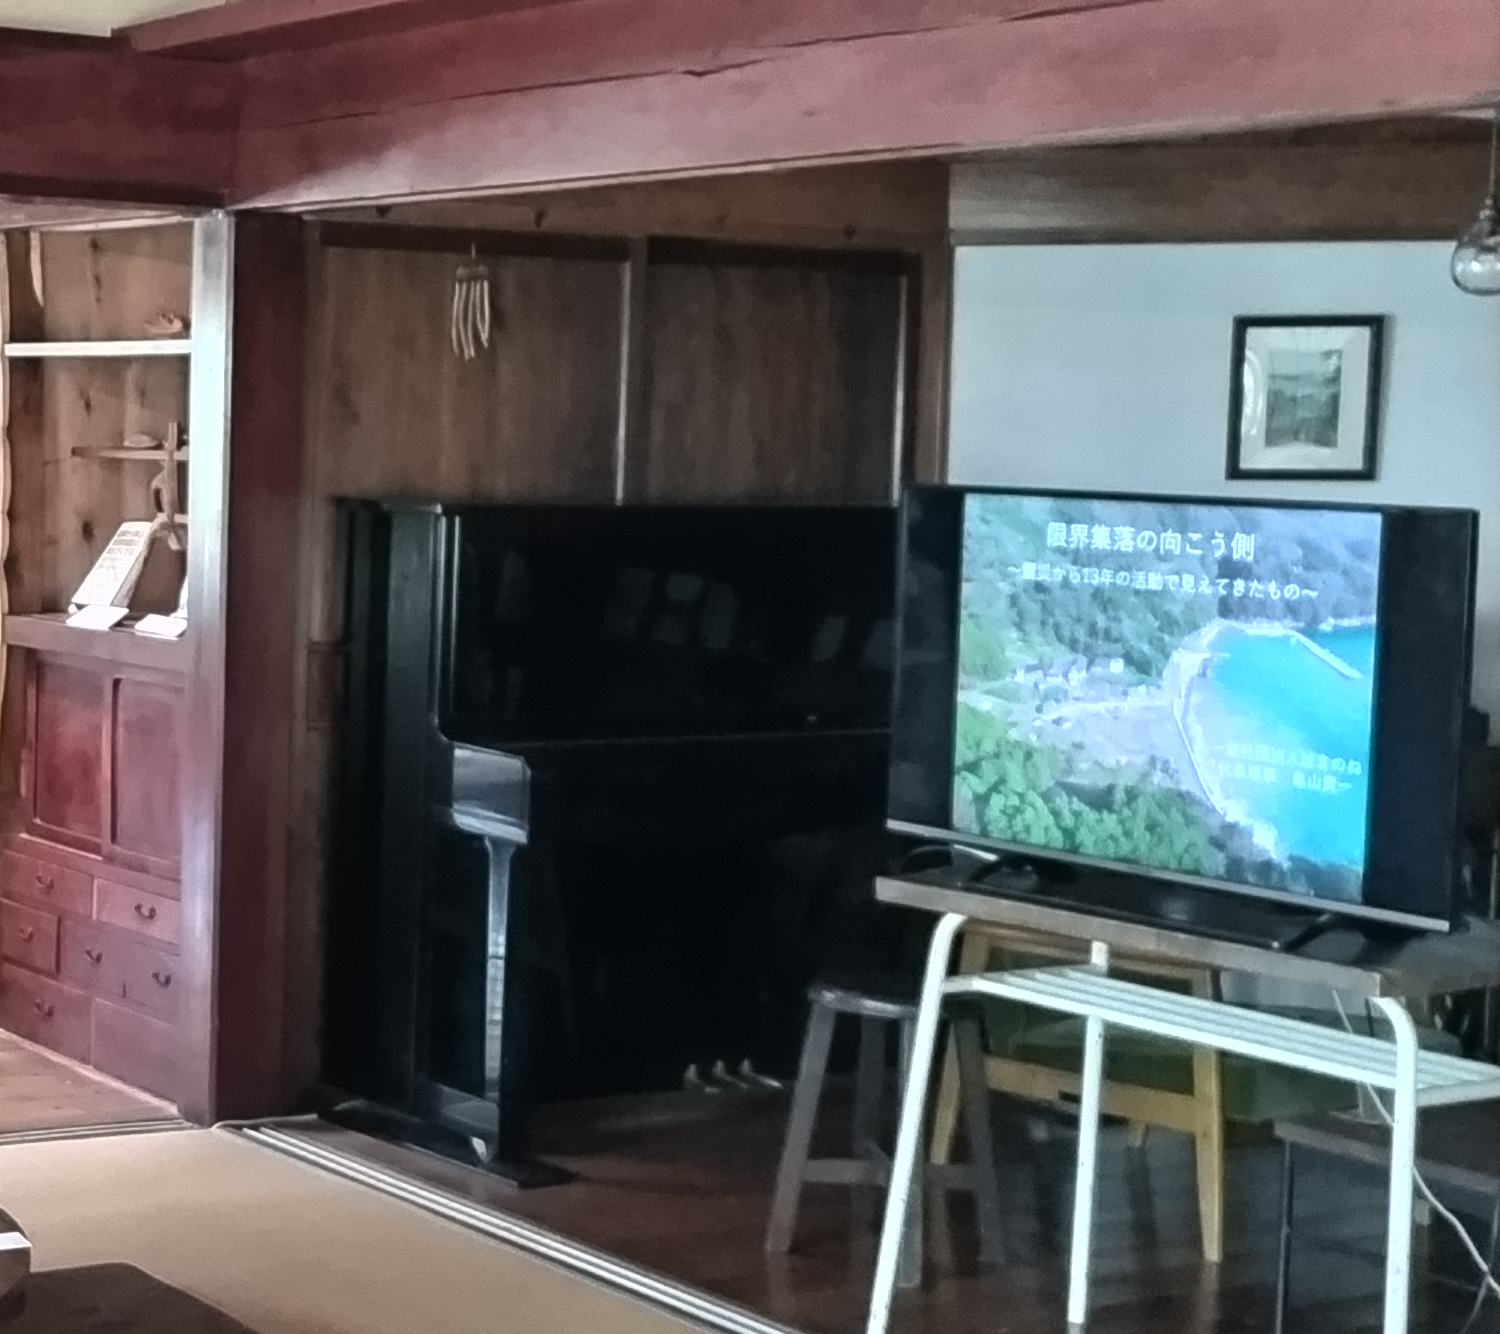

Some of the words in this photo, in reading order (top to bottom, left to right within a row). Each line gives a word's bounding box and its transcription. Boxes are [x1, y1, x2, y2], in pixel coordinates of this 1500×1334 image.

[1047, 521, 1255, 562] 限界集落の向こう側
